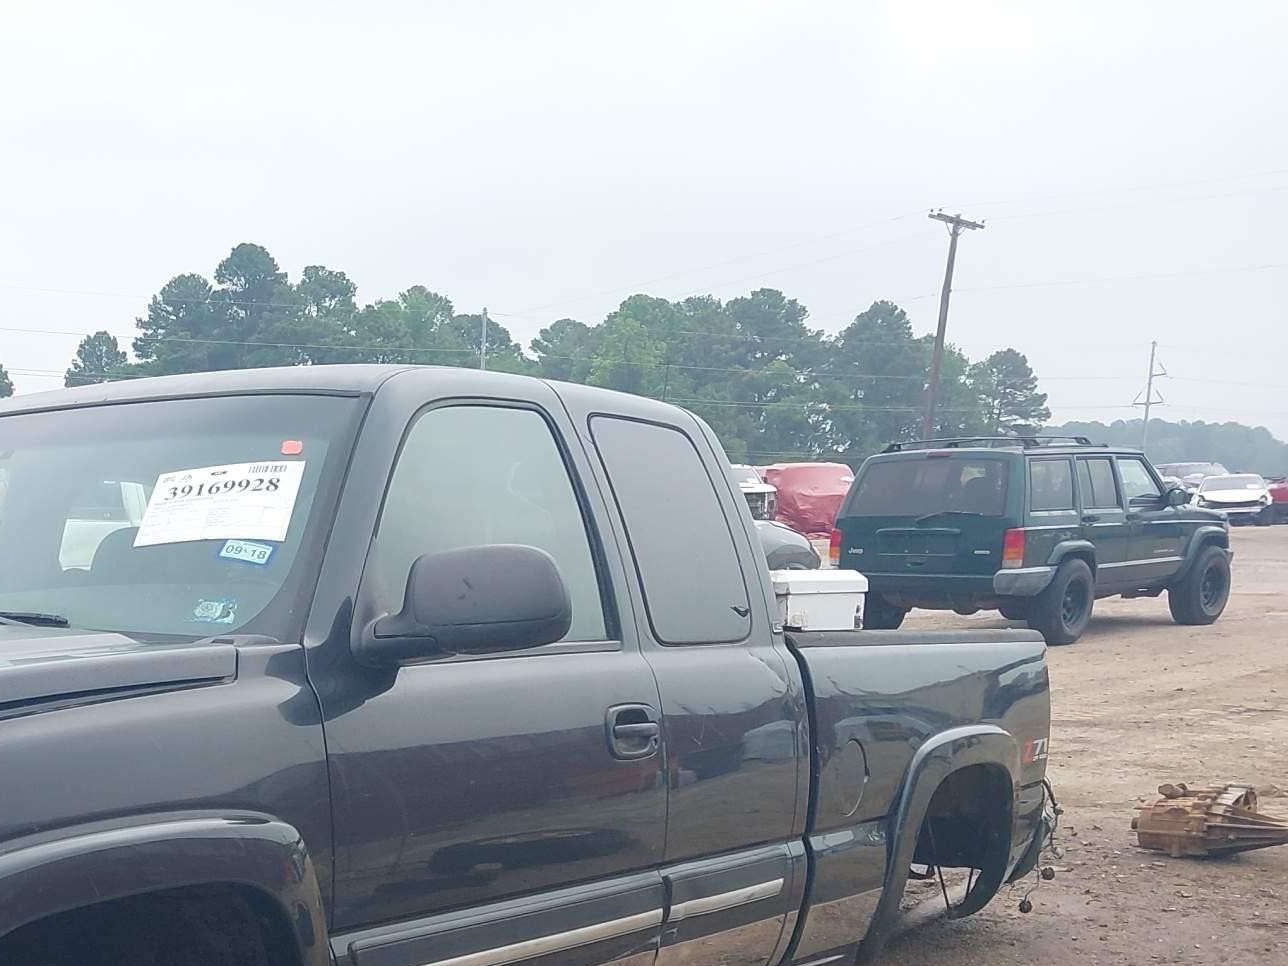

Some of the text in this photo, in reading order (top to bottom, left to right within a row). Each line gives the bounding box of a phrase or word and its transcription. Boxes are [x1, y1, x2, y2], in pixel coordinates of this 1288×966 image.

[164, 477, 281, 501] 39169928
[225, 544, 243, 555] 09
[250, 549, 268, 560] 18
